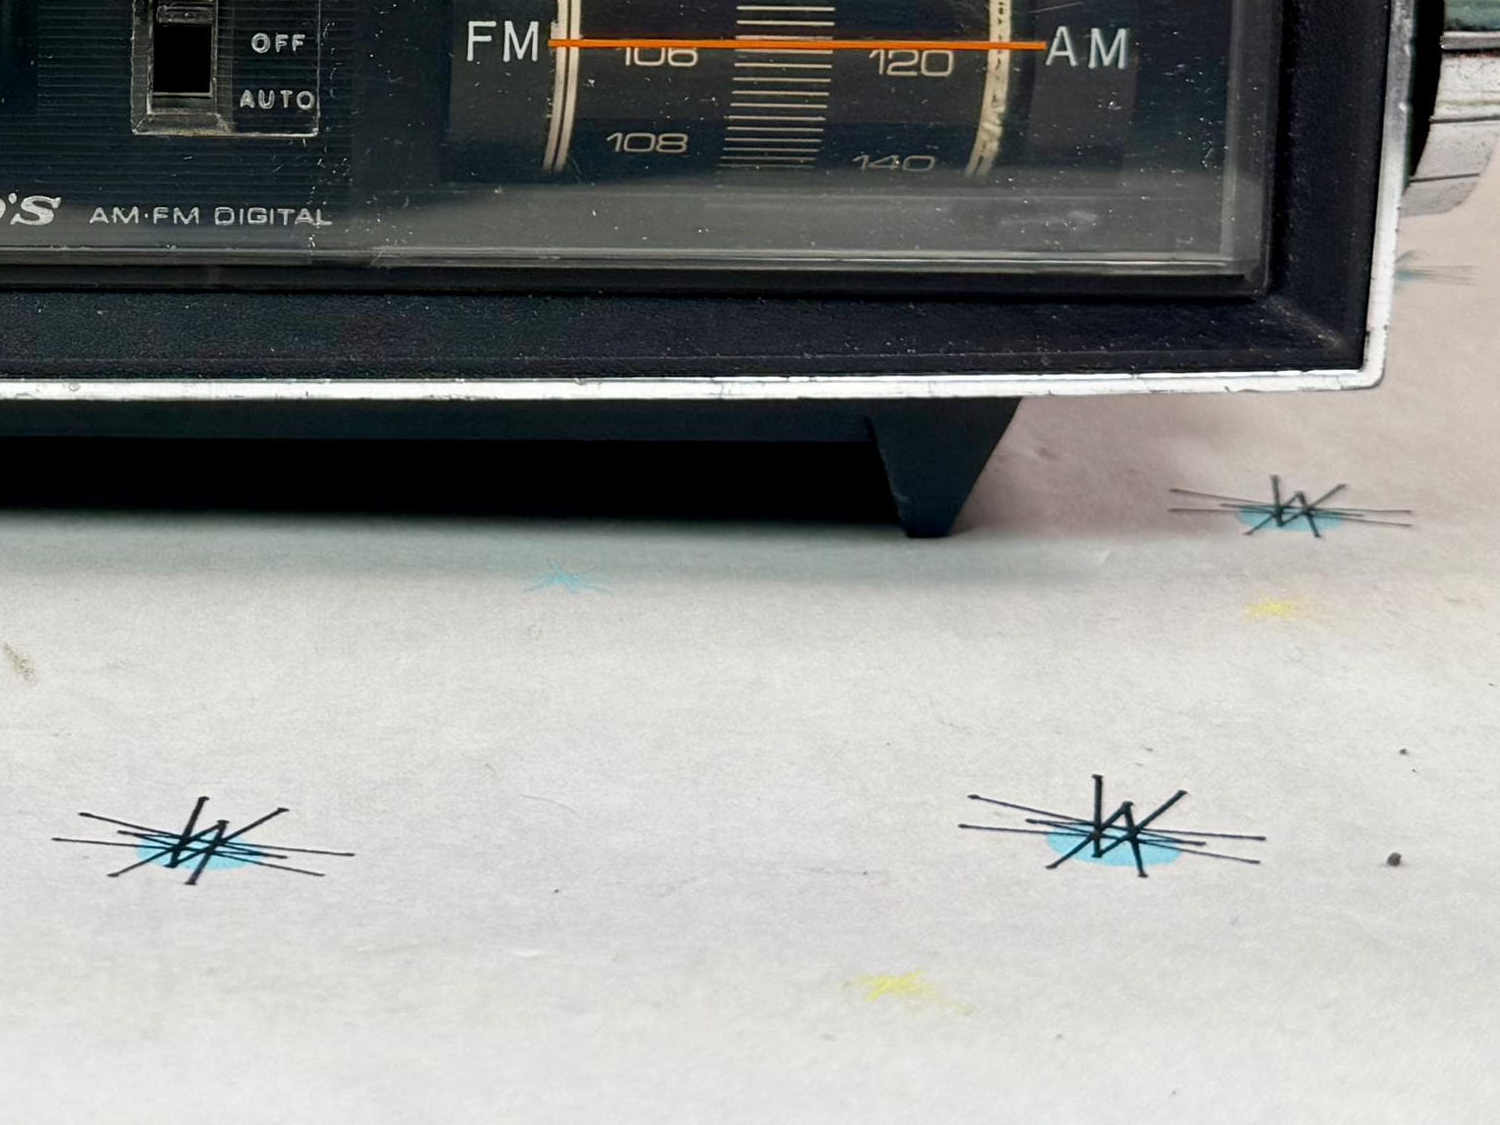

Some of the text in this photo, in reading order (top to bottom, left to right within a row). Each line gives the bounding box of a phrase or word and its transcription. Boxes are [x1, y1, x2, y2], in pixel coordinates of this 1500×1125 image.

[251, 32, 306, 54] OFF
[466, 20, 540, 63] FM
[1045, 25, 1128, 70] AM
[624, 46, 699, 67] 106
[868, 47, 955, 77] 120
[239, 89, 316, 110] AUTO
[606, 132, 688, 154] 108
[852, 155, 936, 172] 140
[214, 207, 333, 226] DIGITAL
